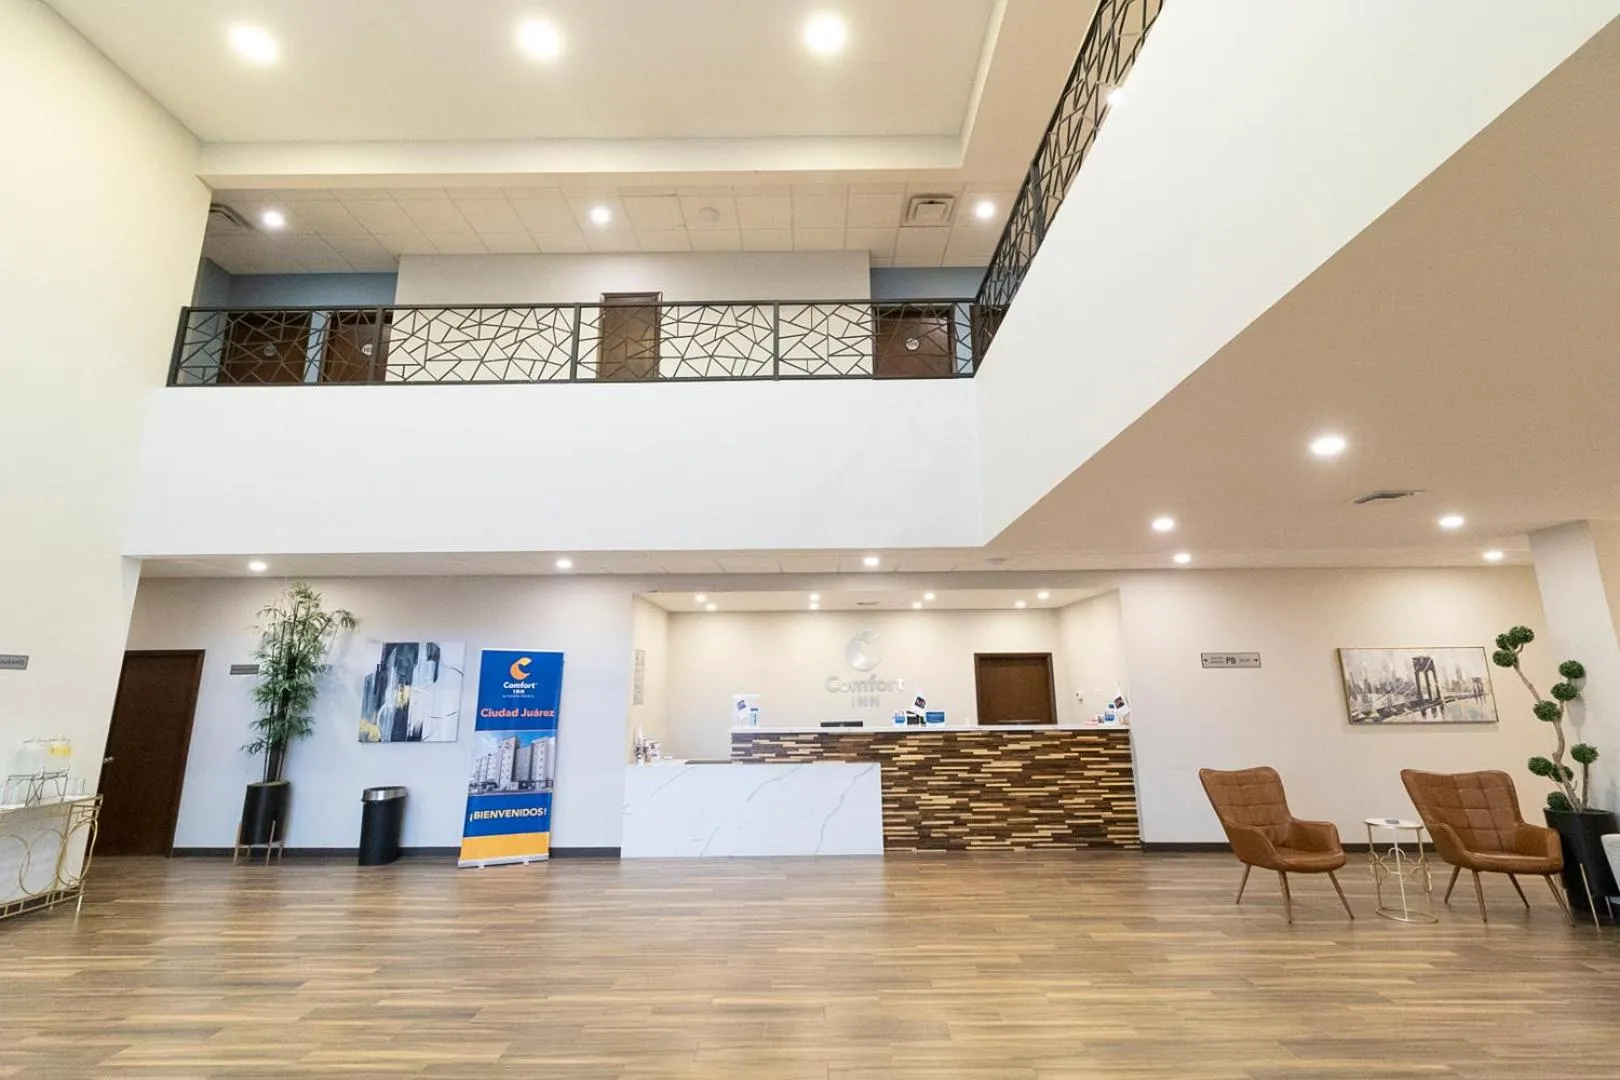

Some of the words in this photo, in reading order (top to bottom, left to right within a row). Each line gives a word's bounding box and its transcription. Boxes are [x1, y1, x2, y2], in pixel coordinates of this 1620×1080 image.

[1225, 656, 1237, 664] PB
[503, 681, 536, 689] Comfort
[825, 674, 906, 693] Comfort
[851, 695, 880, 708] INN
[480, 708, 519, 718] Ciudad
[521, 708, 555, 718] Juárez
[469, 807, 547, 822] ¡BIENVENIDOS!
